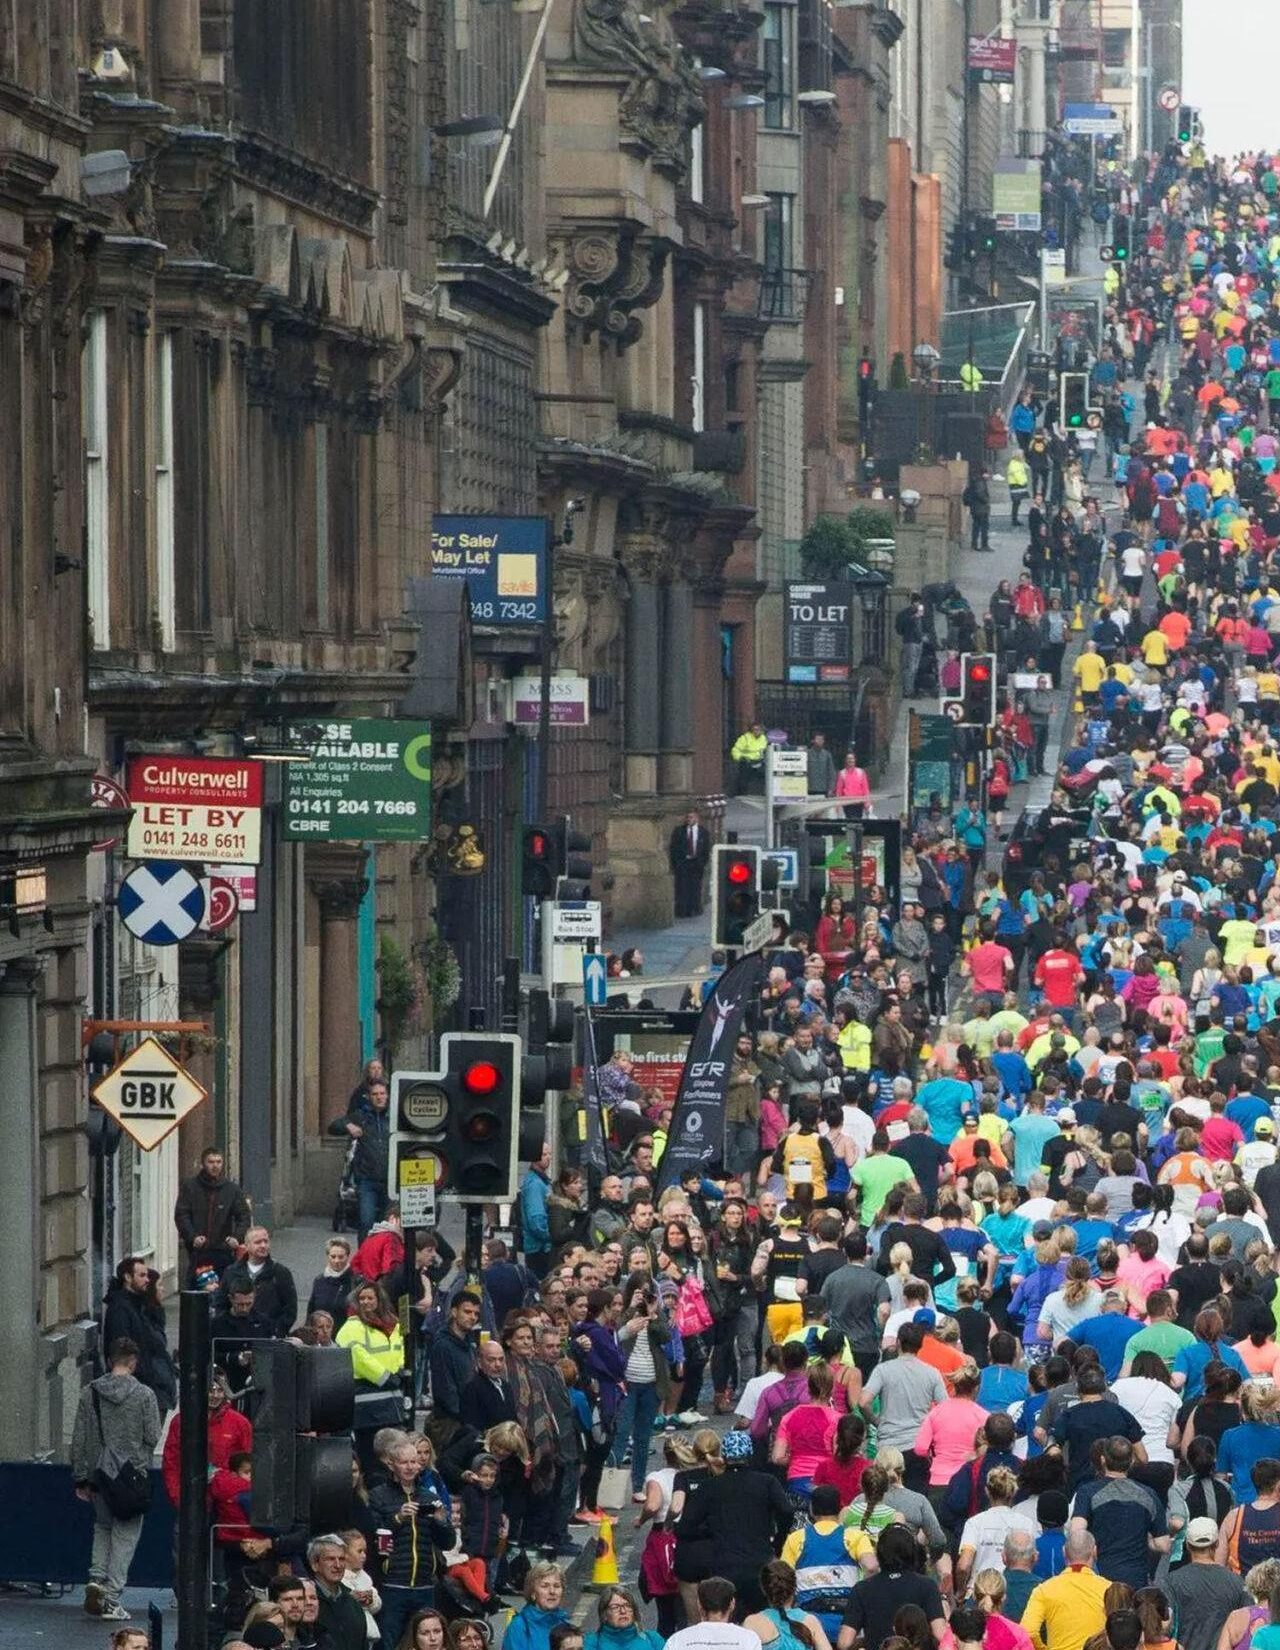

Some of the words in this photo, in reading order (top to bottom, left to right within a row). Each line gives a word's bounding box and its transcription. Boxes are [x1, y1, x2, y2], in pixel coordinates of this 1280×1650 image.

[459, 533, 498, 548] Sale/
[432, 551, 461, 566] May
[466, 550, 490, 564] Let
[501, 580, 534, 593] savills
[501, 602, 536, 619] 7342
[790, 605, 814, 621] TO
[818, 605, 848, 621] LET
[529, 683, 572, 694] MSS
[290, 724, 352, 740] LSE
[290, 742, 399, 758] AILABLE
[289, 762, 317, 771] Benefit
[318, 762, 327, 770] of
[328, 762, 350, 771] Class
[360, 763, 392, 772] Consent
[143, 766, 248, 789] Culverwell
[144, 786, 187, 796] PROPERTY
[189, 787, 247, 798] CONSULTANTS
[290, 787, 300, 796] All
[302, 787, 342, 797] Enquiries
[289, 800, 330, 814] 0141
[337, 800, 369, 814] 204
[374, 801, 416, 815] 7666
[143, 807, 193, 826] LET
[207, 810, 245, 828] BY
[289, 820, 330, 832] CBRE
[143, 830, 175, 845] 0141
[182, 832, 208, 847] 248
[215, 833, 245, 849] 6611
[143, 848, 245, 858] www.culverwell.co.uk
[575, 925, 595, 934] Stop
[646, 1051, 670, 1063] first
[121, 1082, 176, 1109] GBK
